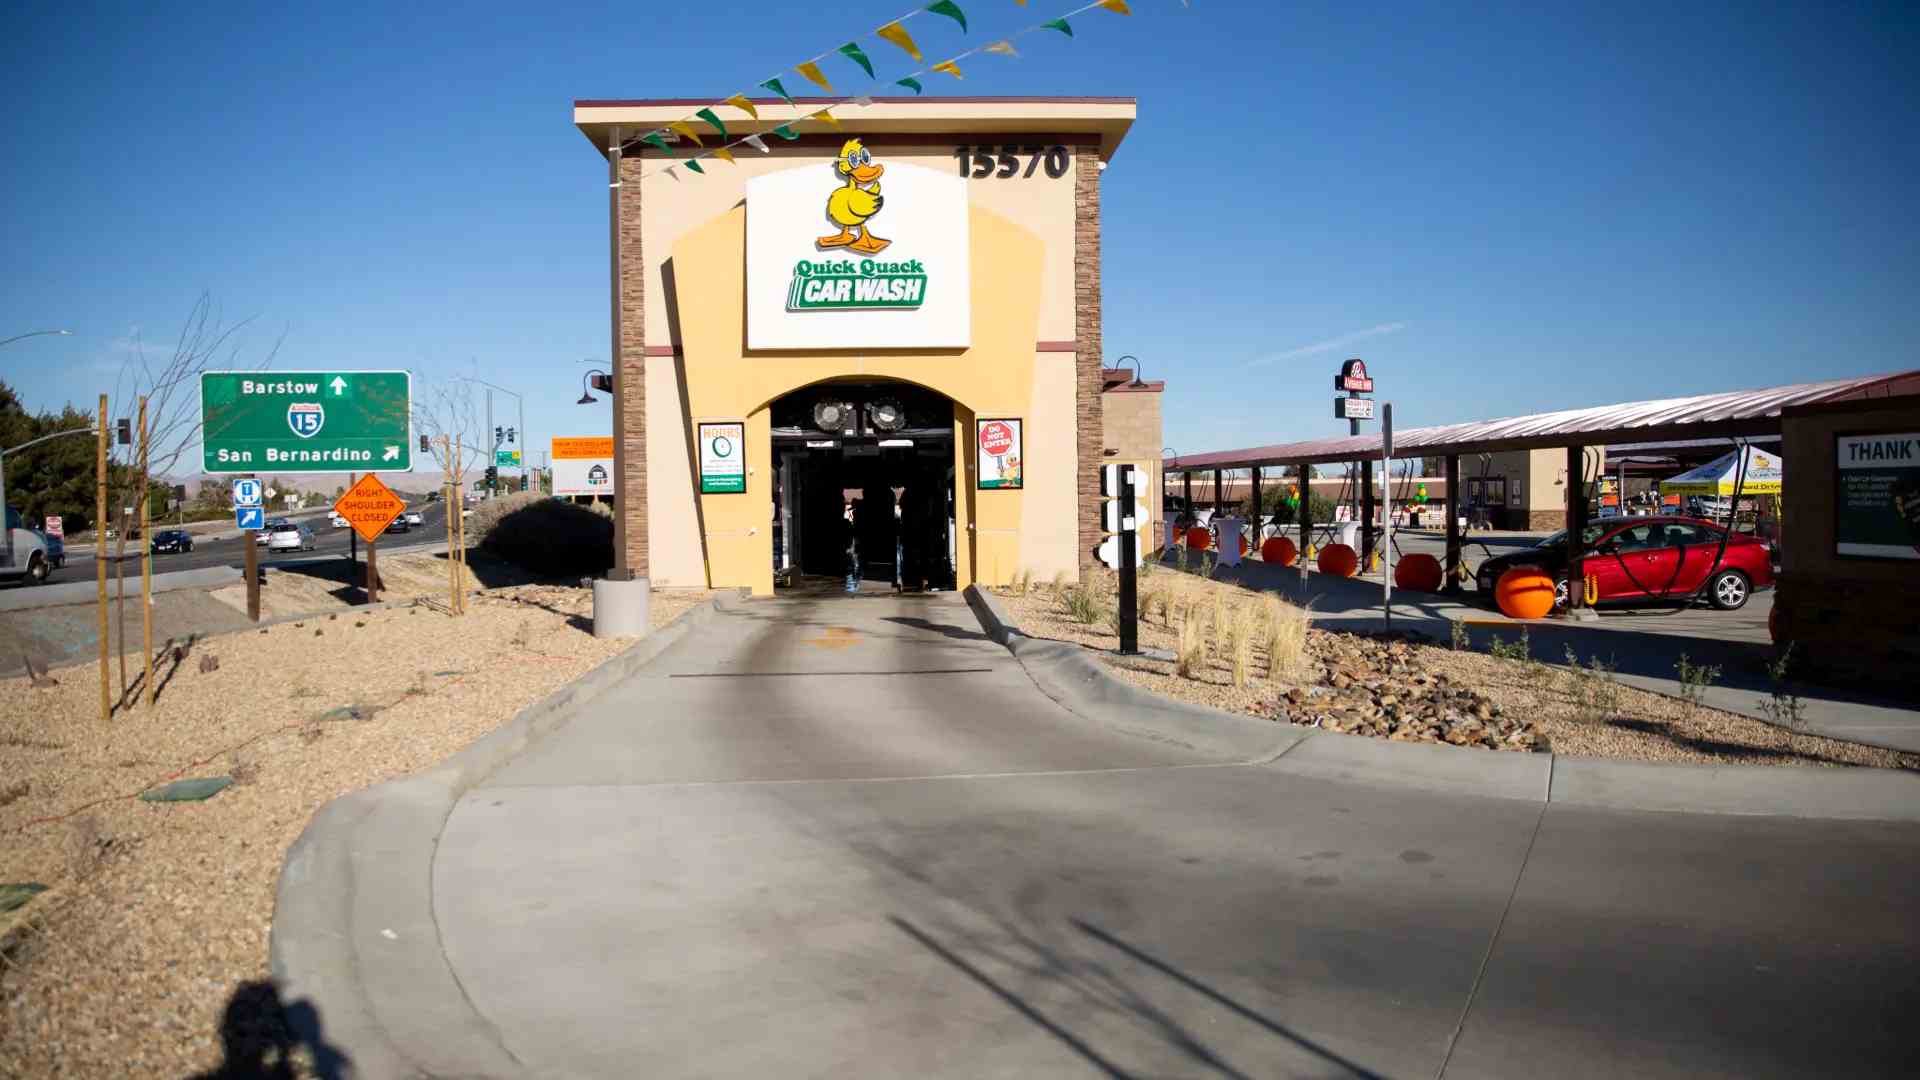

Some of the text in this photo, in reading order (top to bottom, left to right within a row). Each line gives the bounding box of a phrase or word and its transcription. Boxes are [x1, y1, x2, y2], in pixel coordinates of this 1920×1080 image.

[953, 145, 1070, 179] 15570
[797, 259, 925, 277] Quick Quack
[804, 278, 922, 302] CAR WASH
[242, 381, 319, 394] Barstow
[296, 413, 318, 431] 15
[218, 448, 371, 462] San Bernardino
[1848, 440, 1912, 461] THANK
[355, 488, 383, 497] RIGHT
[344, 501, 395, 510] SHOULDER
[352, 513, 388, 522] CLOSED
